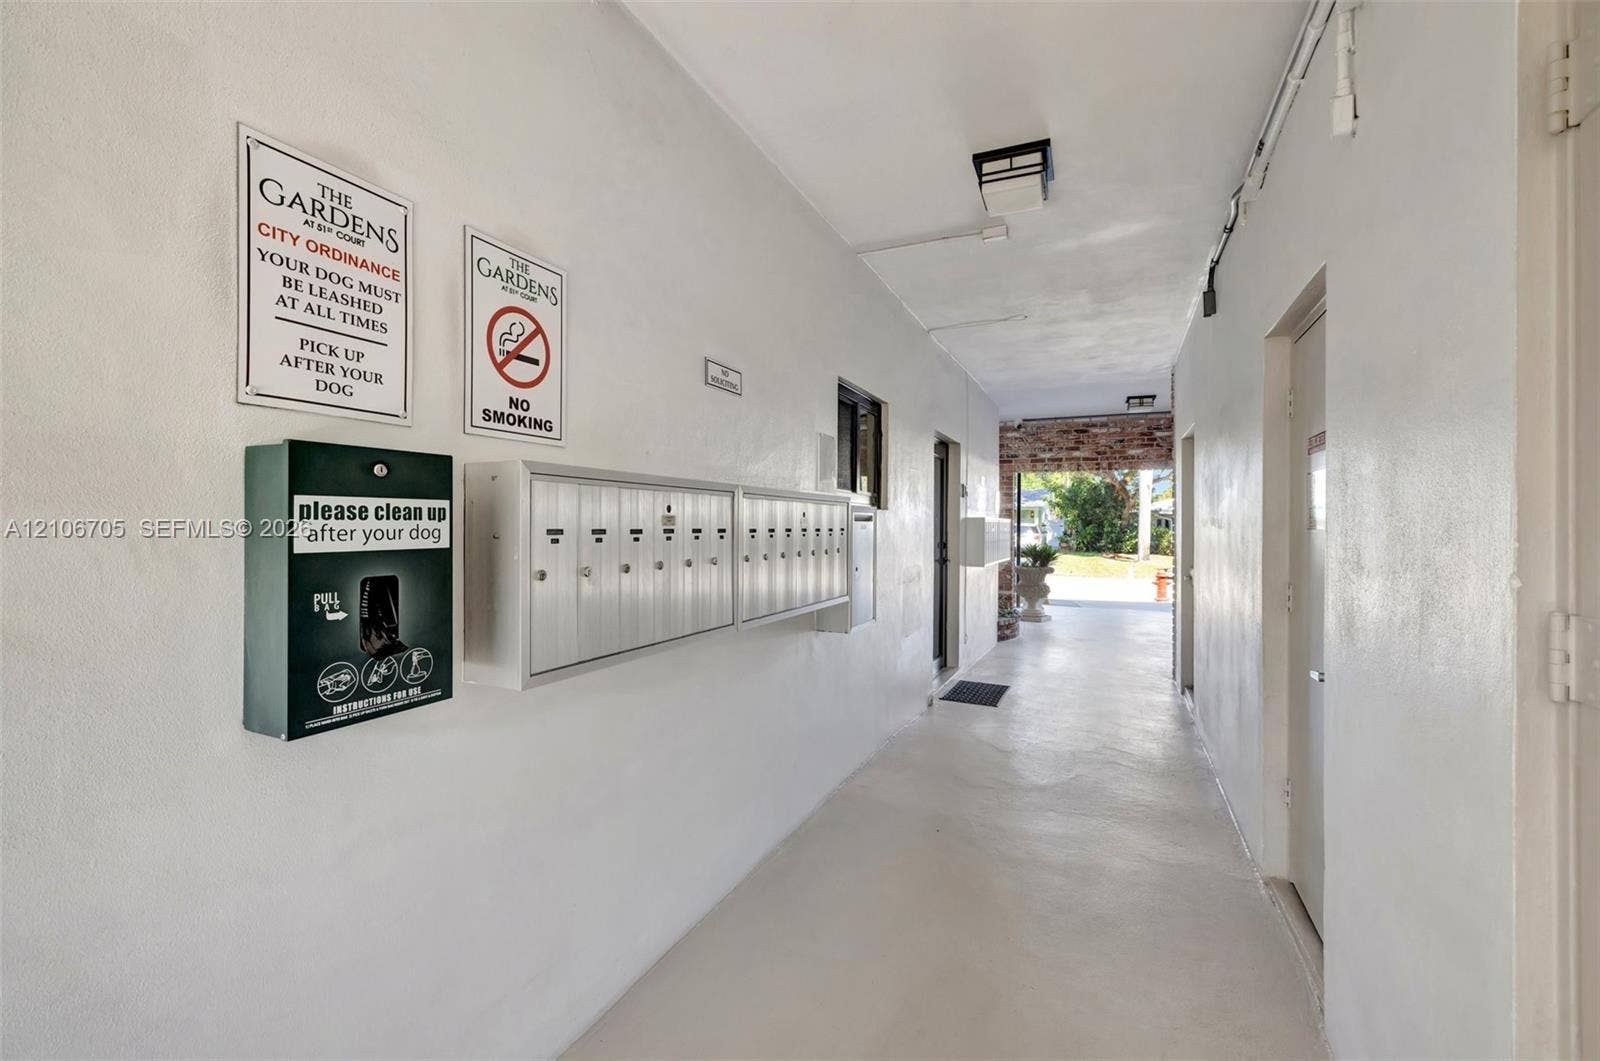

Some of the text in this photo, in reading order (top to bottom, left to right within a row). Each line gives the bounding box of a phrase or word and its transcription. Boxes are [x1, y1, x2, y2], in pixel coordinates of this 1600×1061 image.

[317, 182, 352, 210] THE
[259, 178, 399, 253] GARDENS
[303, 219, 314, 228] AT
[336, 231, 365, 247] COURT
[257, 222, 400, 282] CITY ORDINANCE
[257, 247, 402, 304] YOUR DOG MUST
[509, 257, 530, 276] THE
[282, 275, 383, 315] BE LEASHED
[477, 257, 558, 306] GARDENS
[275, 294, 388, 334] AT ALL TIMES
[299, 338, 365, 363] PICK UP
[279, 354, 384, 385] AFTER YOUR
[315, 379, 354, 397] DOG
[509, 396, 530, 412] NO
[482, 408, 553, 433] SMOKING
[299, 501, 446, 523] please clean up
[307, 524, 441, 546] after your dog
[314, 592, 339, 605] PULL
[314, 601, 340, 612] BAG
[333, 693, 392, 715] INSTRUCTIONS
[393, 690, 407, 700] FOR
[408, 686, 422, 696] USE
